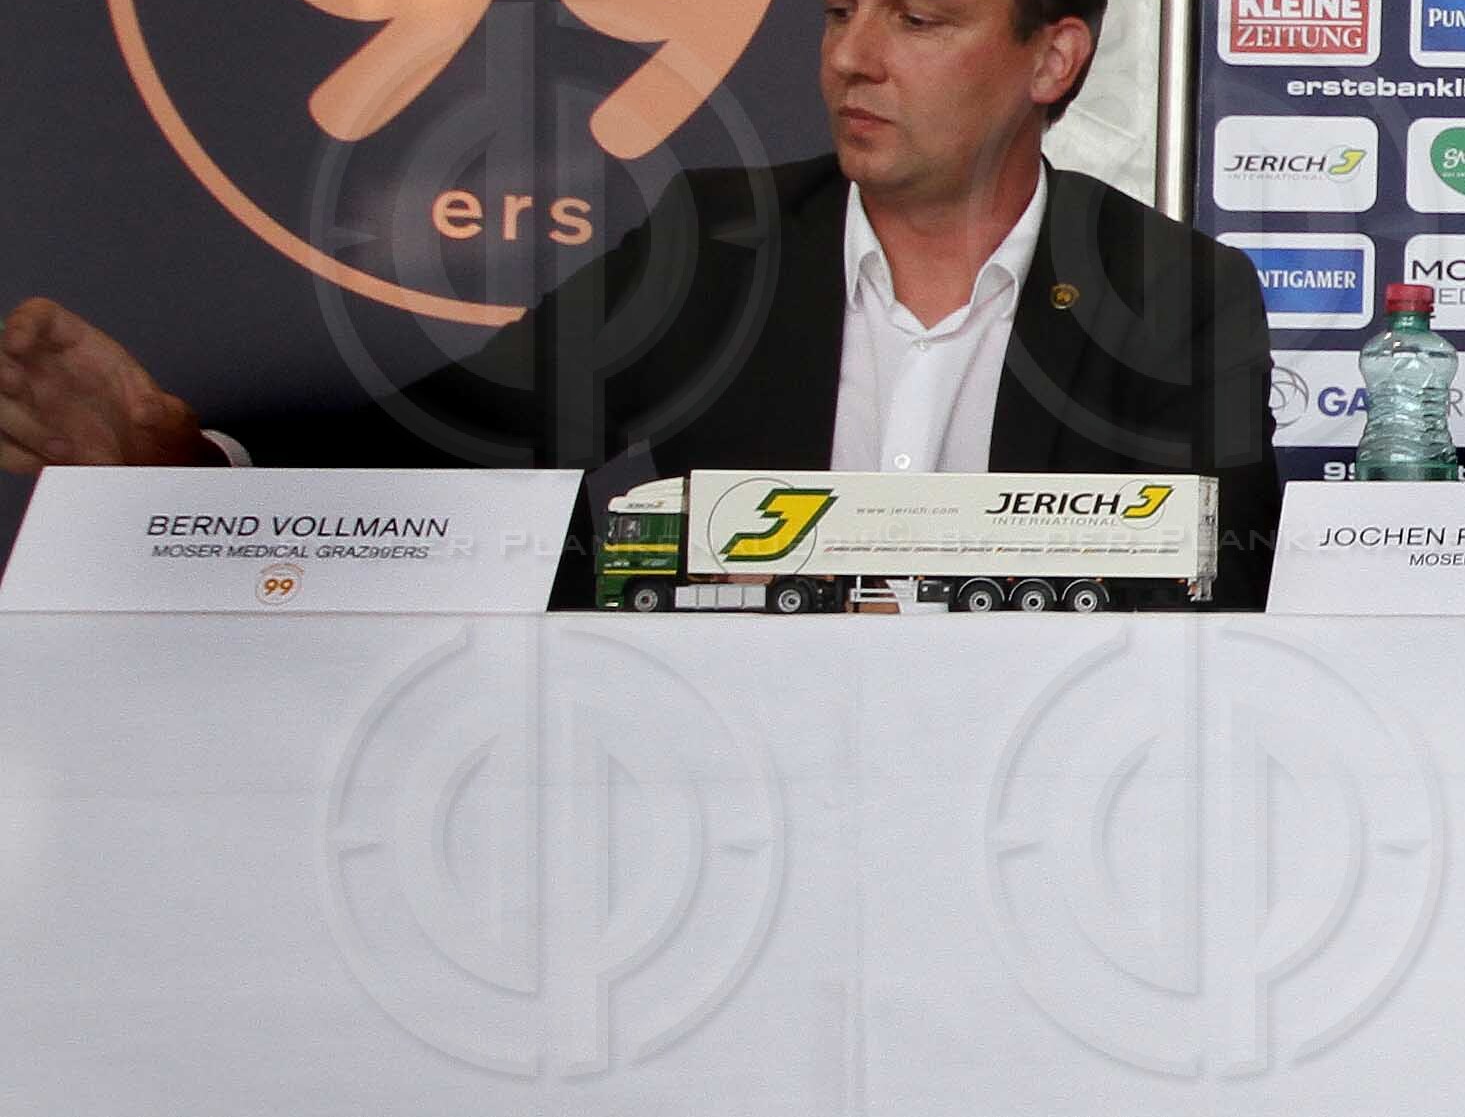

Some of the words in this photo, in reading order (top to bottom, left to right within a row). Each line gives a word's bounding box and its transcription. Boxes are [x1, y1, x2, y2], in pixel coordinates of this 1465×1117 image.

[1237, 26, 1362, 50] ZEITUNG
[1225, 155, 1326, 174] JERICH
[431, 187, 594, 245] ers
[986, 493, 1121, 515] JERICH
[146, 515, 261, 537] BERND
[272, 516, 449, 538] VOLLMANN
[1319, 526, 1446, 547] JOCHEN
[152, 546, 223, 558] MOSER
[228, 546, 309, 558] MEDICAL
[315, 546, 430, 560] GRAZ99ERS
[264, 579, 293, 595] 99
